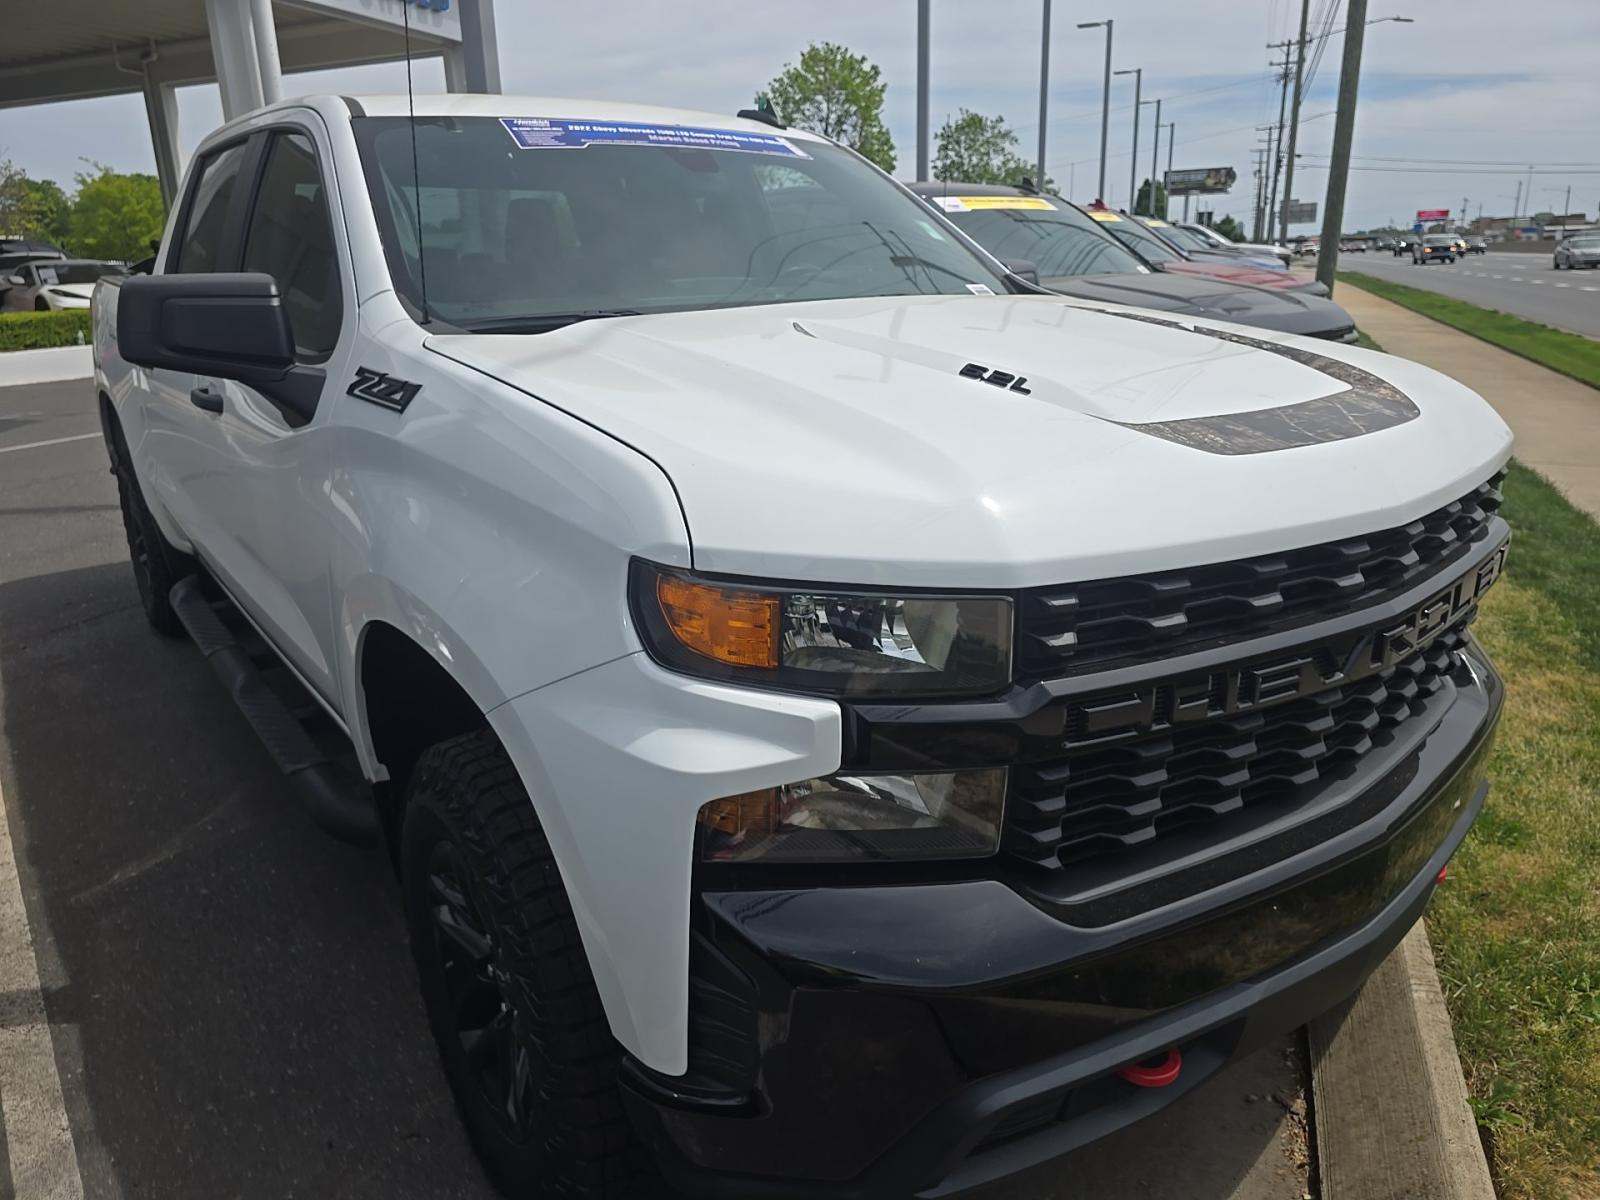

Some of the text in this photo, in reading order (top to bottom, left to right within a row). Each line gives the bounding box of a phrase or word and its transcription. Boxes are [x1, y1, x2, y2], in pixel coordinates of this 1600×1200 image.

[568, 124, 591, 132] 2022
[592, 125, 617, 133] Chevy
[618, 127, 656, 135] Silverado
[648, 134, 682, 142] Market
[682, 136, 709, 145] Based
[709, 138, 740, 148] Pricing
[958, 362, 1031, 396] 6.2L
